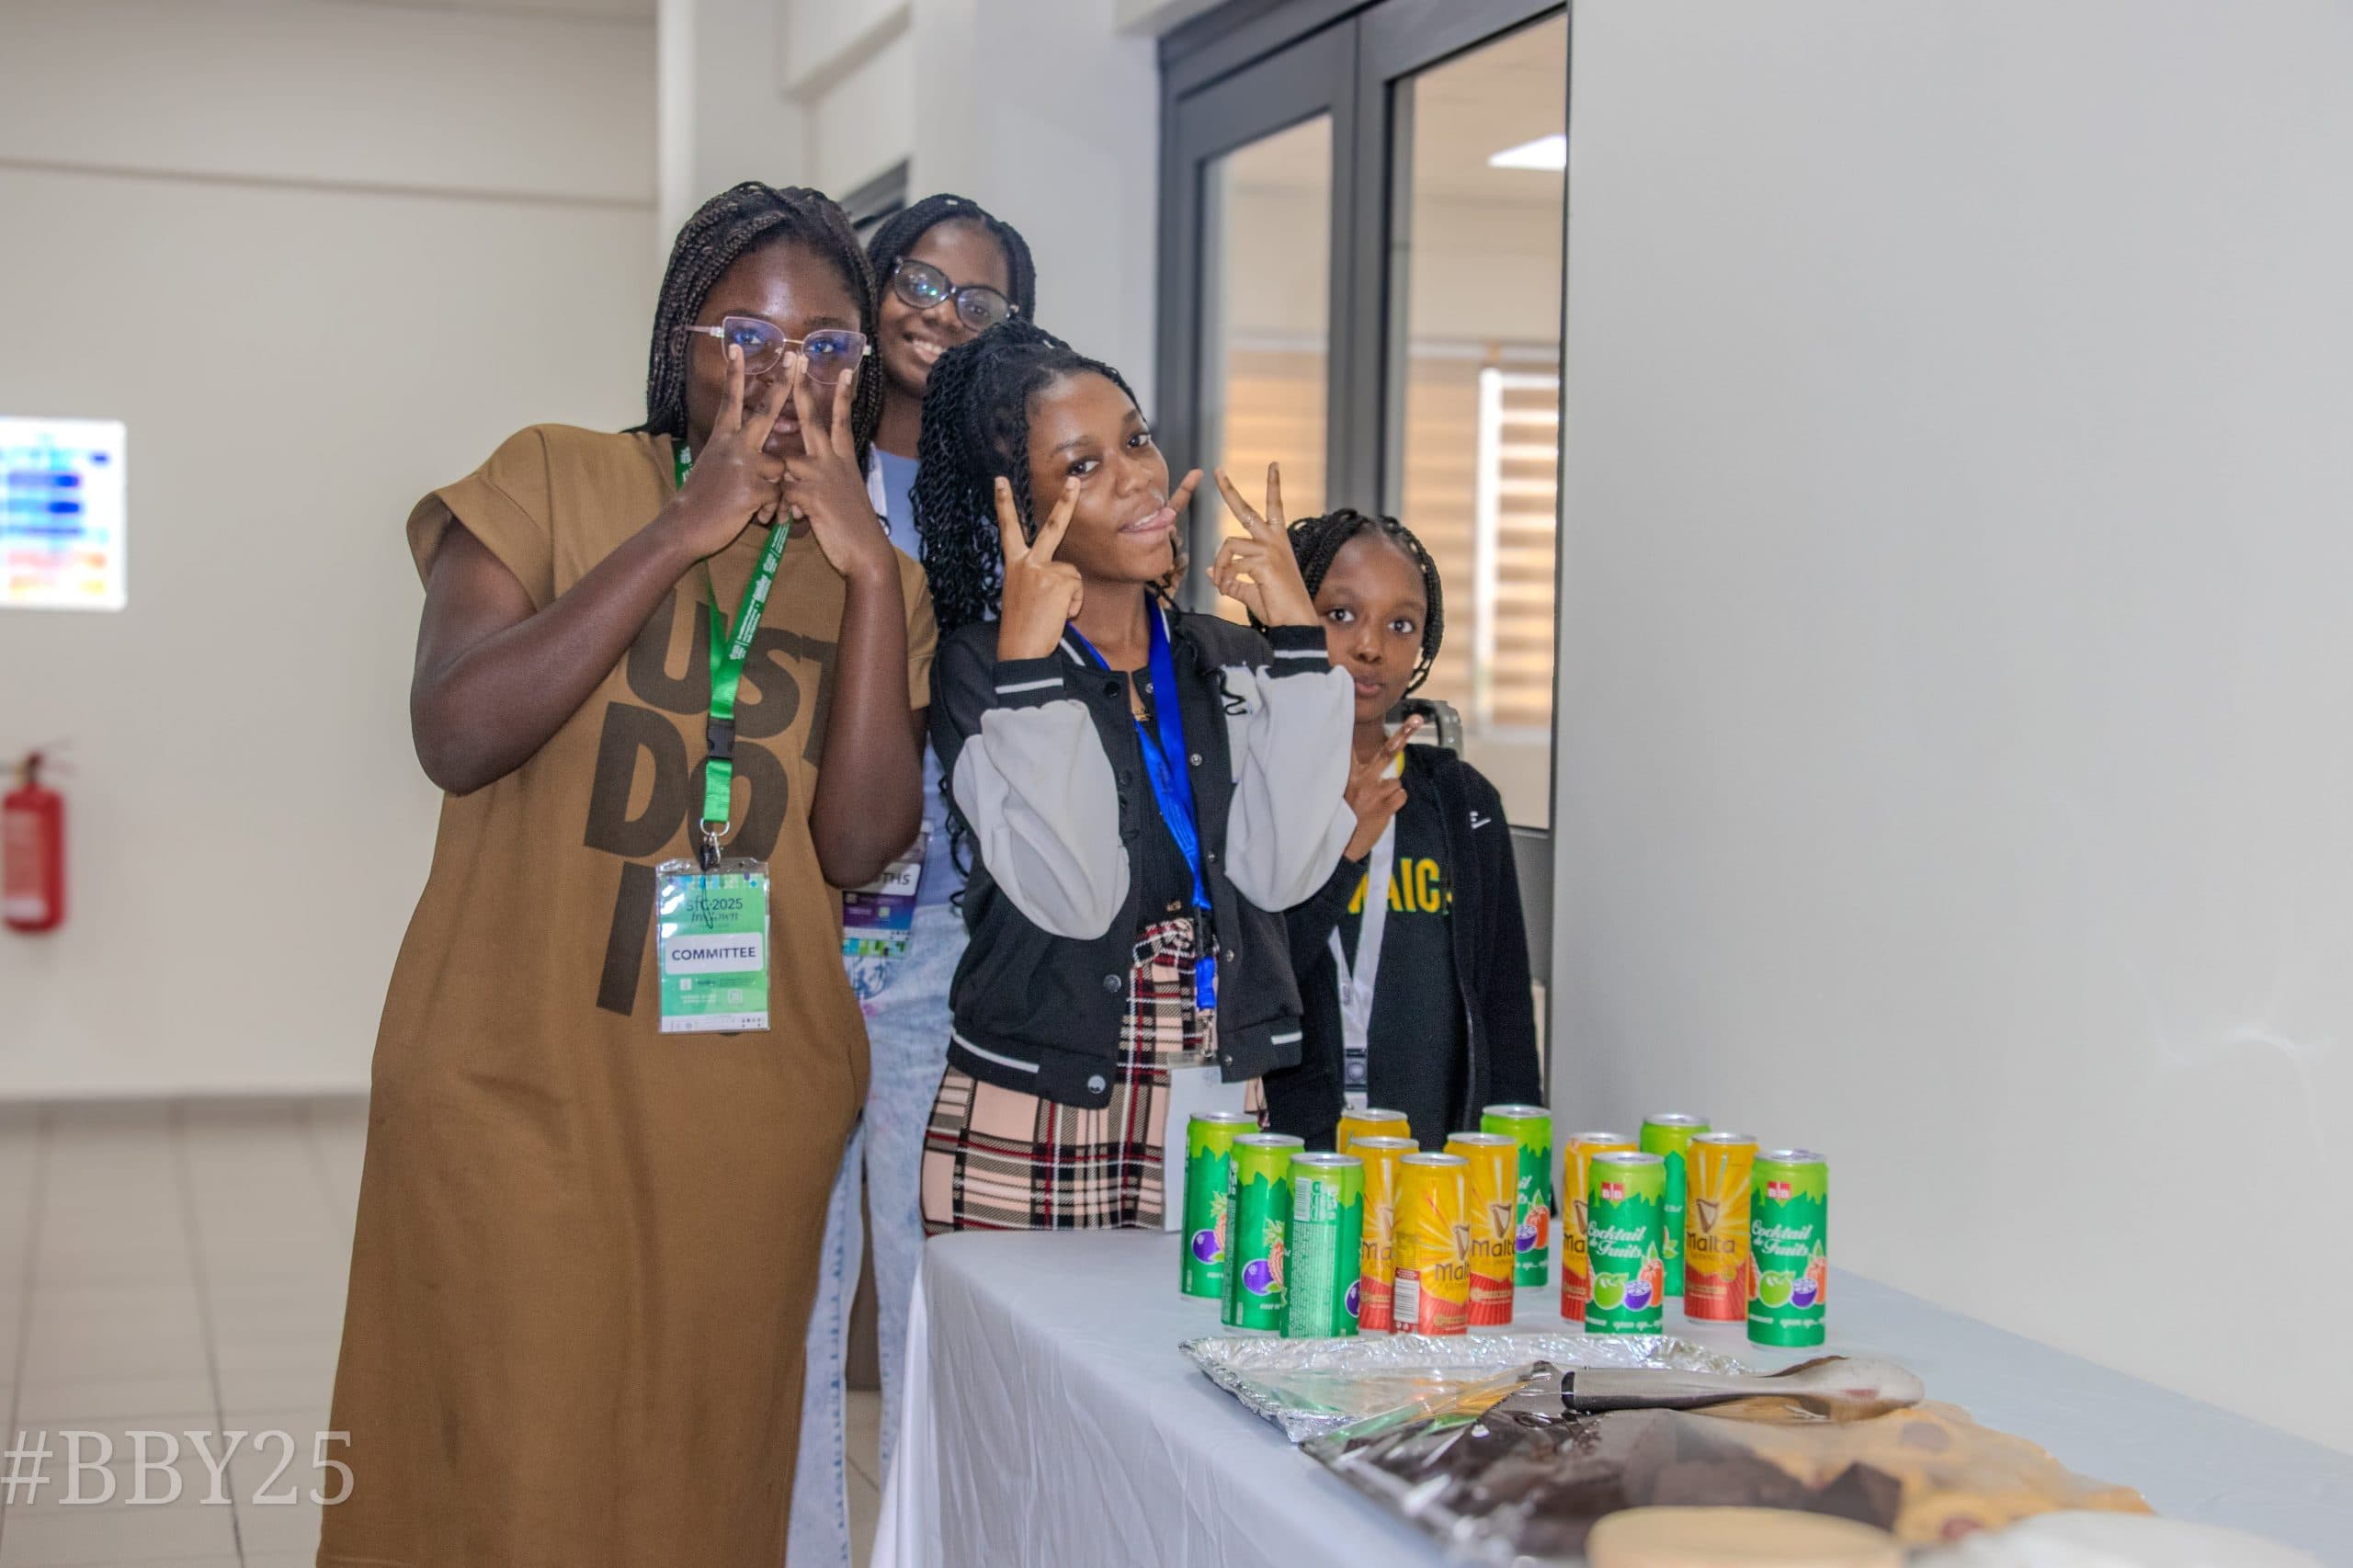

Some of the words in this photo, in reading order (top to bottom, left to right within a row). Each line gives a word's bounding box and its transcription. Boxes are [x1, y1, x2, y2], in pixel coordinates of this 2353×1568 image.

[584, 701, 789, 862] DO
[672, 947, 756, 961] COMMITTEE
[1587, 1221, 1647, 1241] Cocktail
[1751, 1220, 1813, 1240] Cocktail
[1596, 1240, 1643, 1258] Fruits
[1687, 1232, 1735, 1254] Malta
[1760, 1238, 1809, 1256] Fruits
